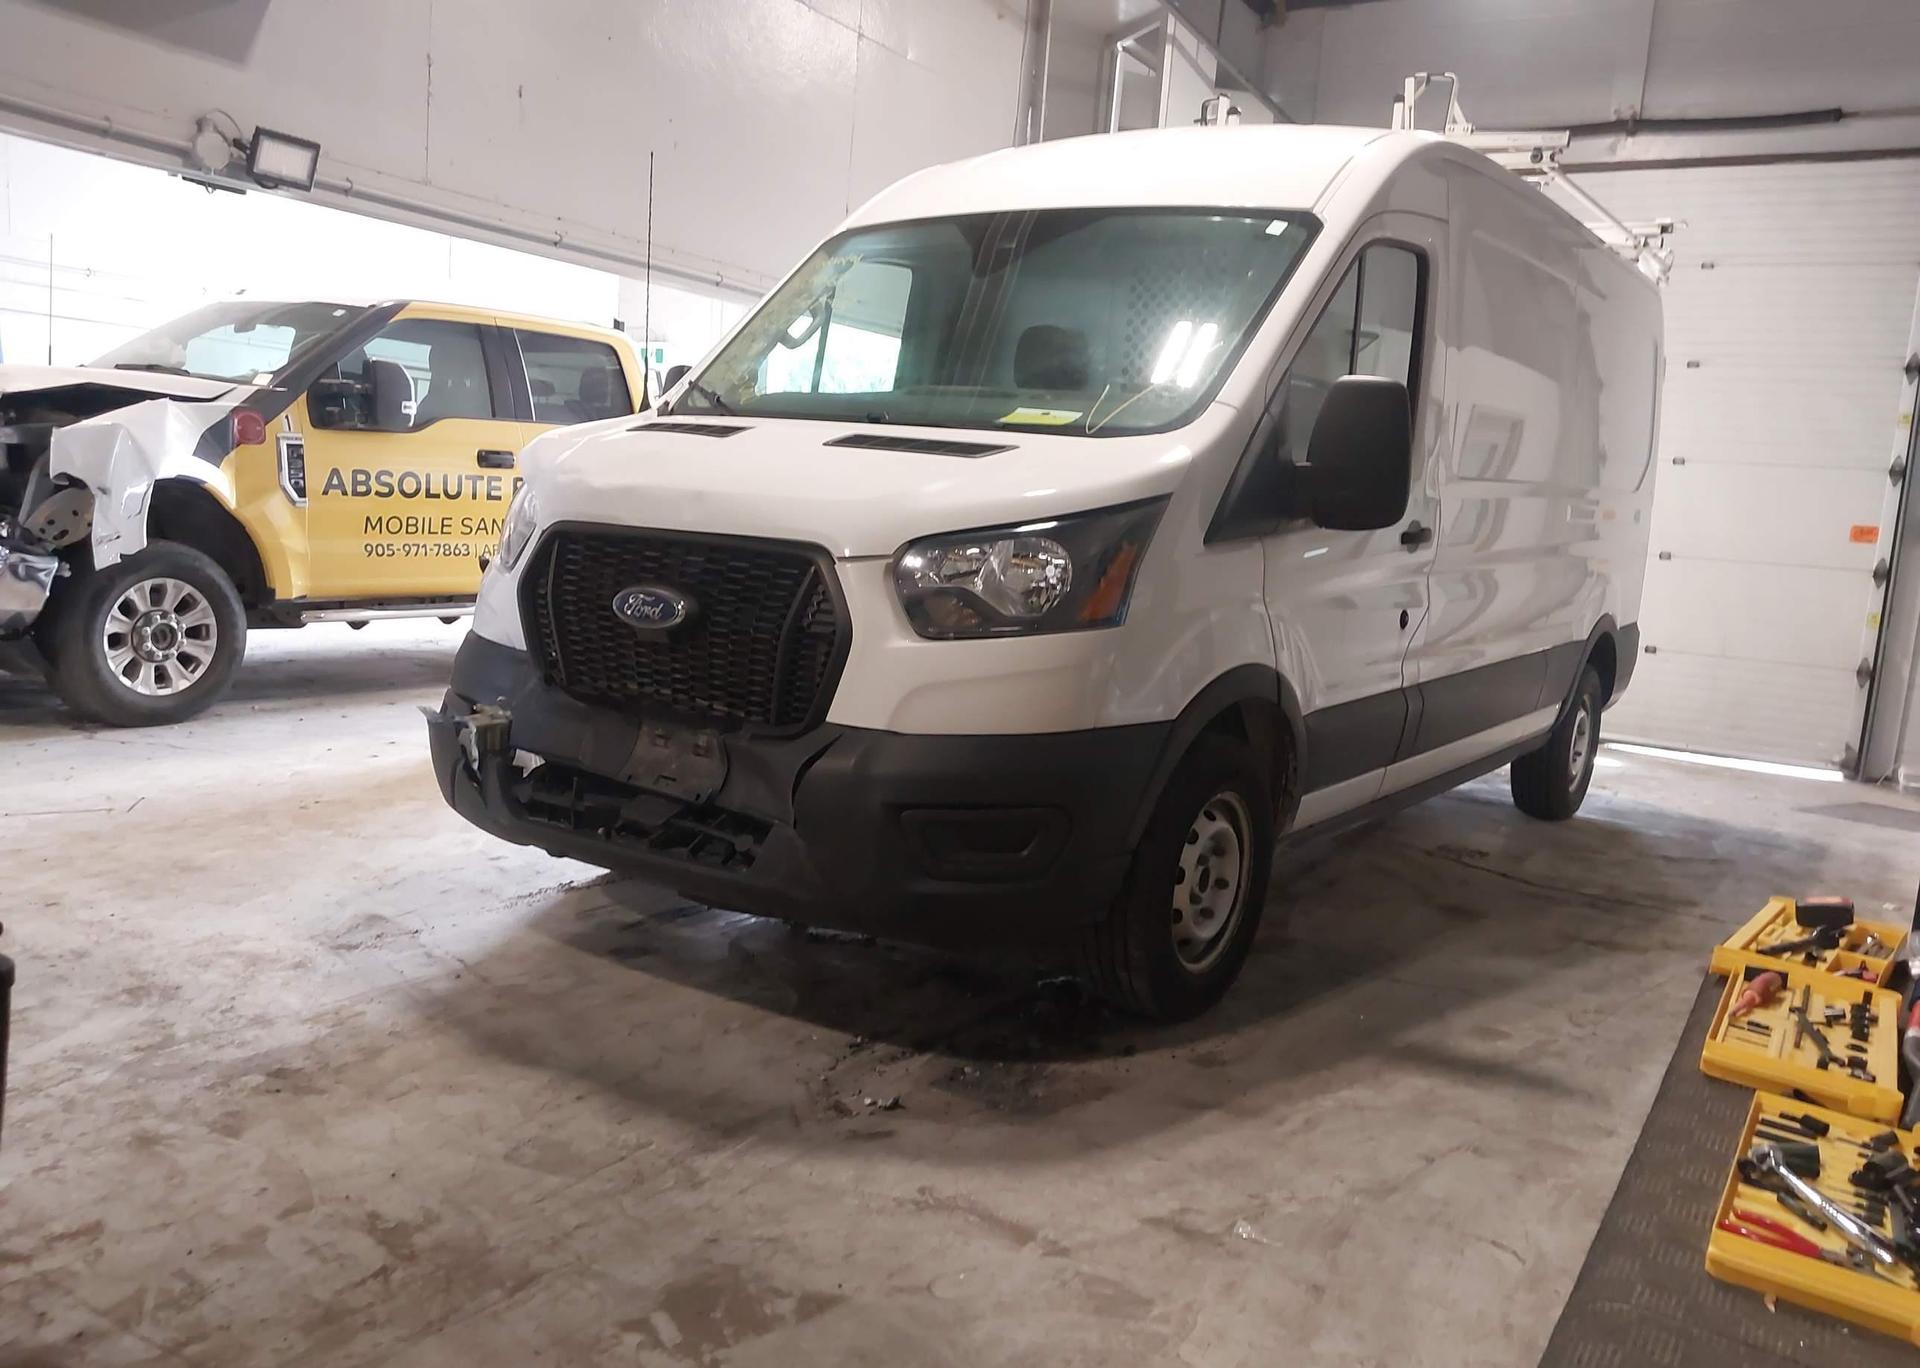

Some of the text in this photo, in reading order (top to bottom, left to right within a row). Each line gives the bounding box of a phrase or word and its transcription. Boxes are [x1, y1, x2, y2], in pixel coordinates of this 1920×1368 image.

[321, 467, 502, 501] ABSOLUTE
[363, 515, 453, 536] MOBILE
[363, 542, 471, 558] 905-971-7863
[624, 593, 664, 619] Ford
